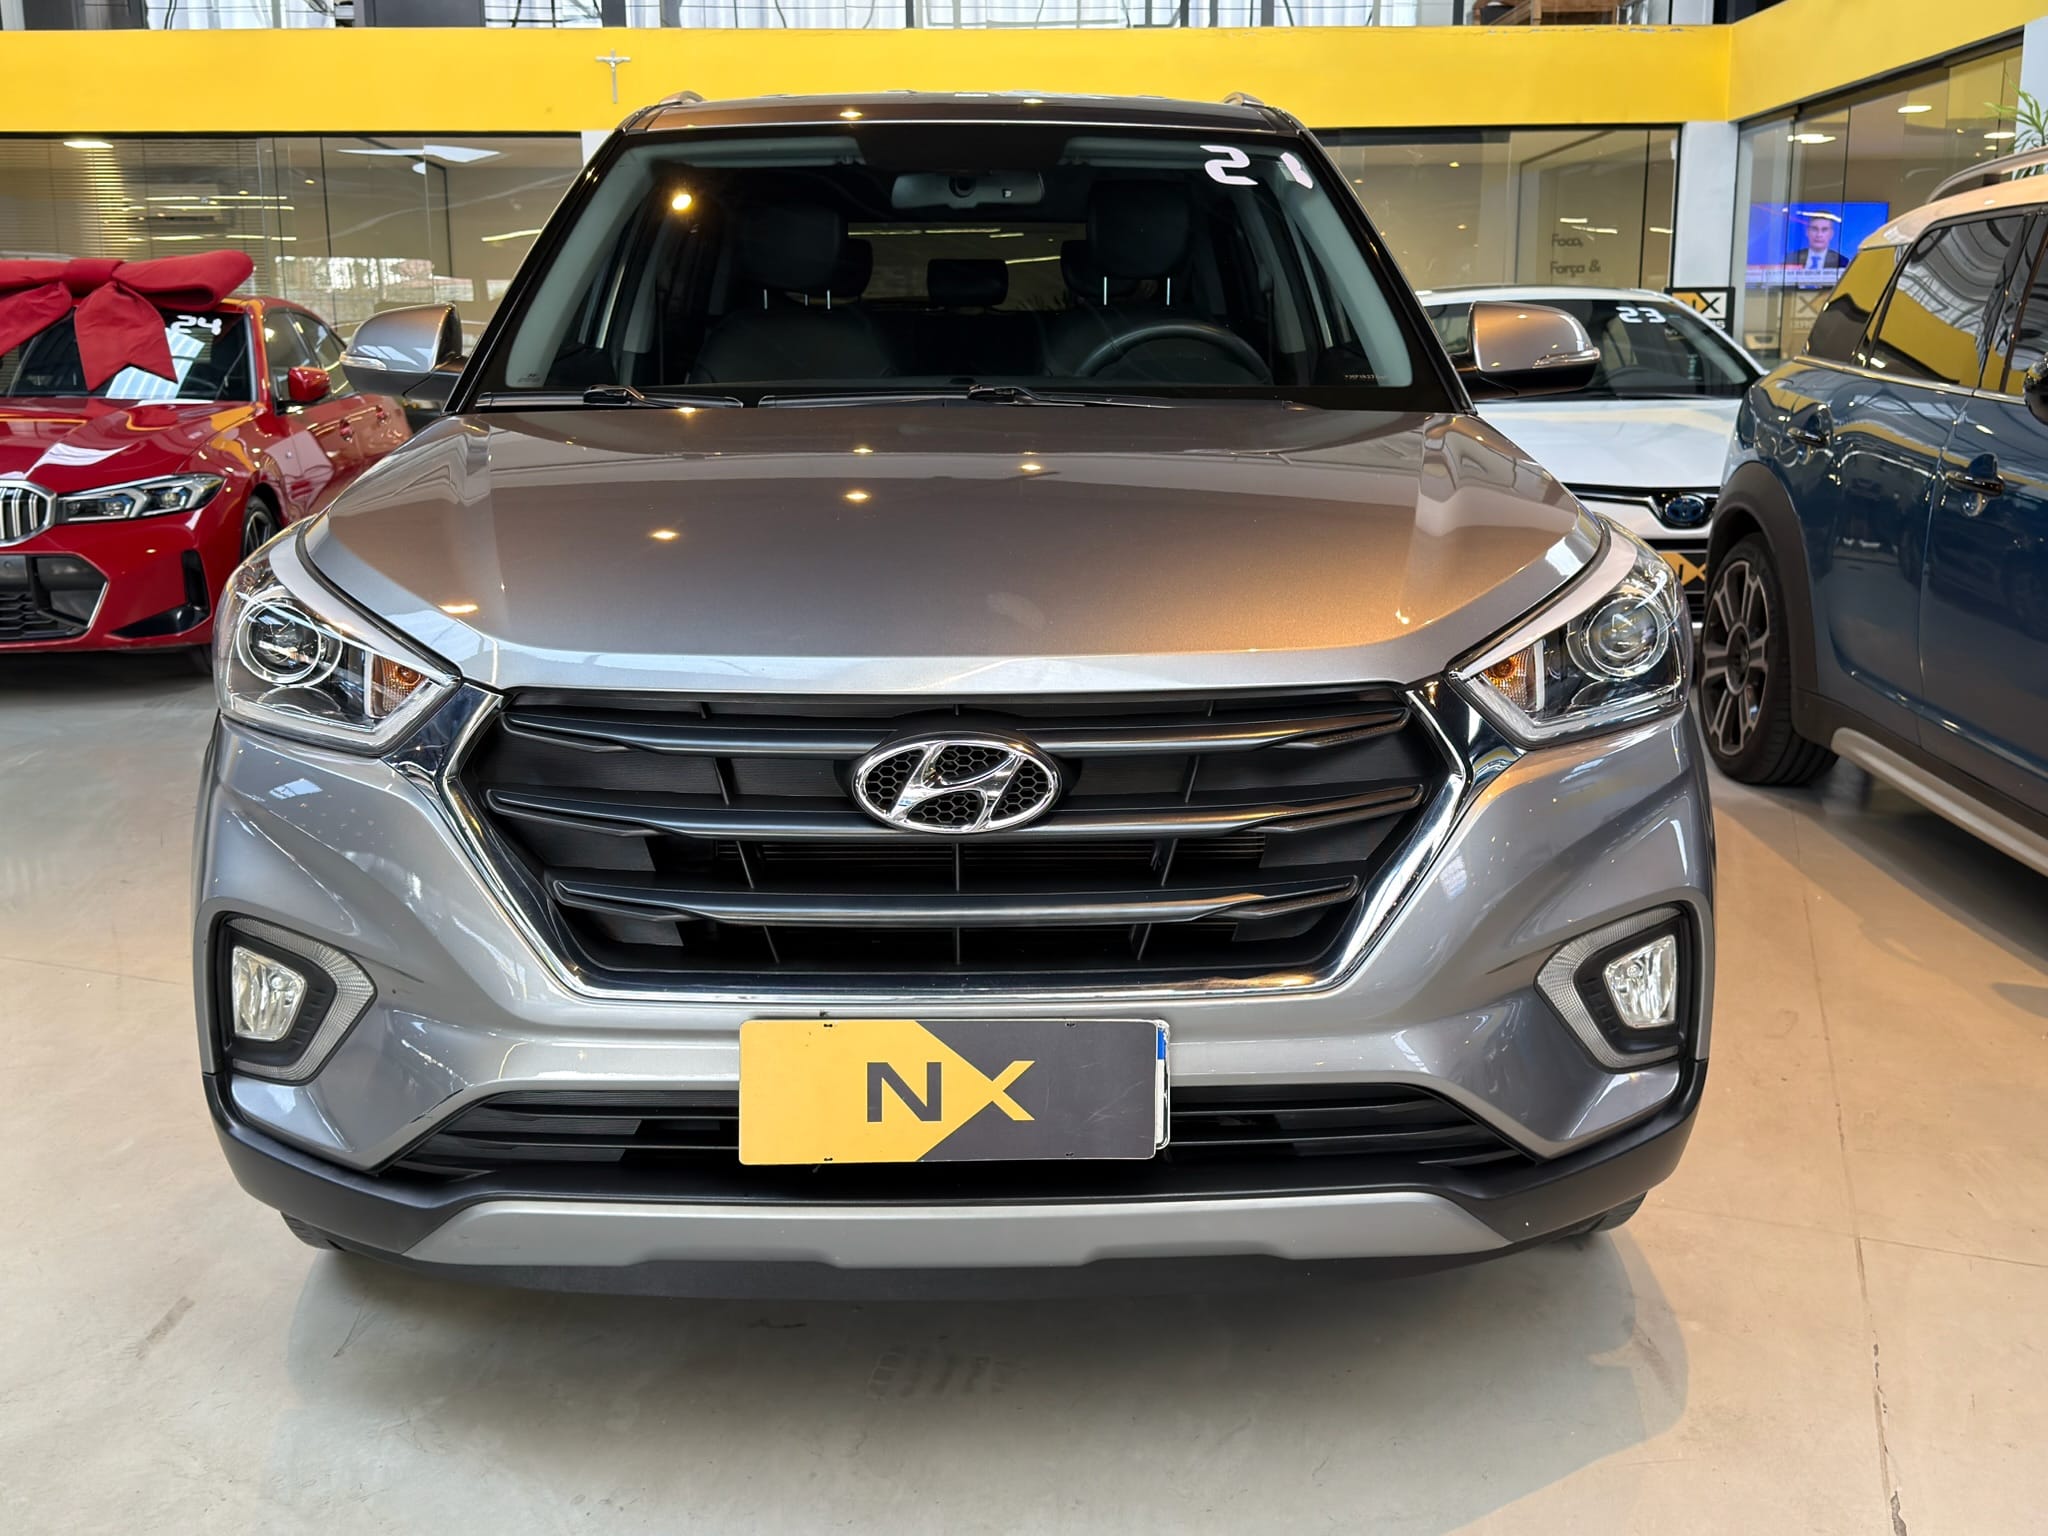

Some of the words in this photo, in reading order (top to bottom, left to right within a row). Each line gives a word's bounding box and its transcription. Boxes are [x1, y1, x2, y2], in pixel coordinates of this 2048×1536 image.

[1199, 144, 1314, 190] 21
[170, 314, 223, 336] 24
[1615, 305, 1667, 324] 23
[866, 1060, 1036, 1123] NX
